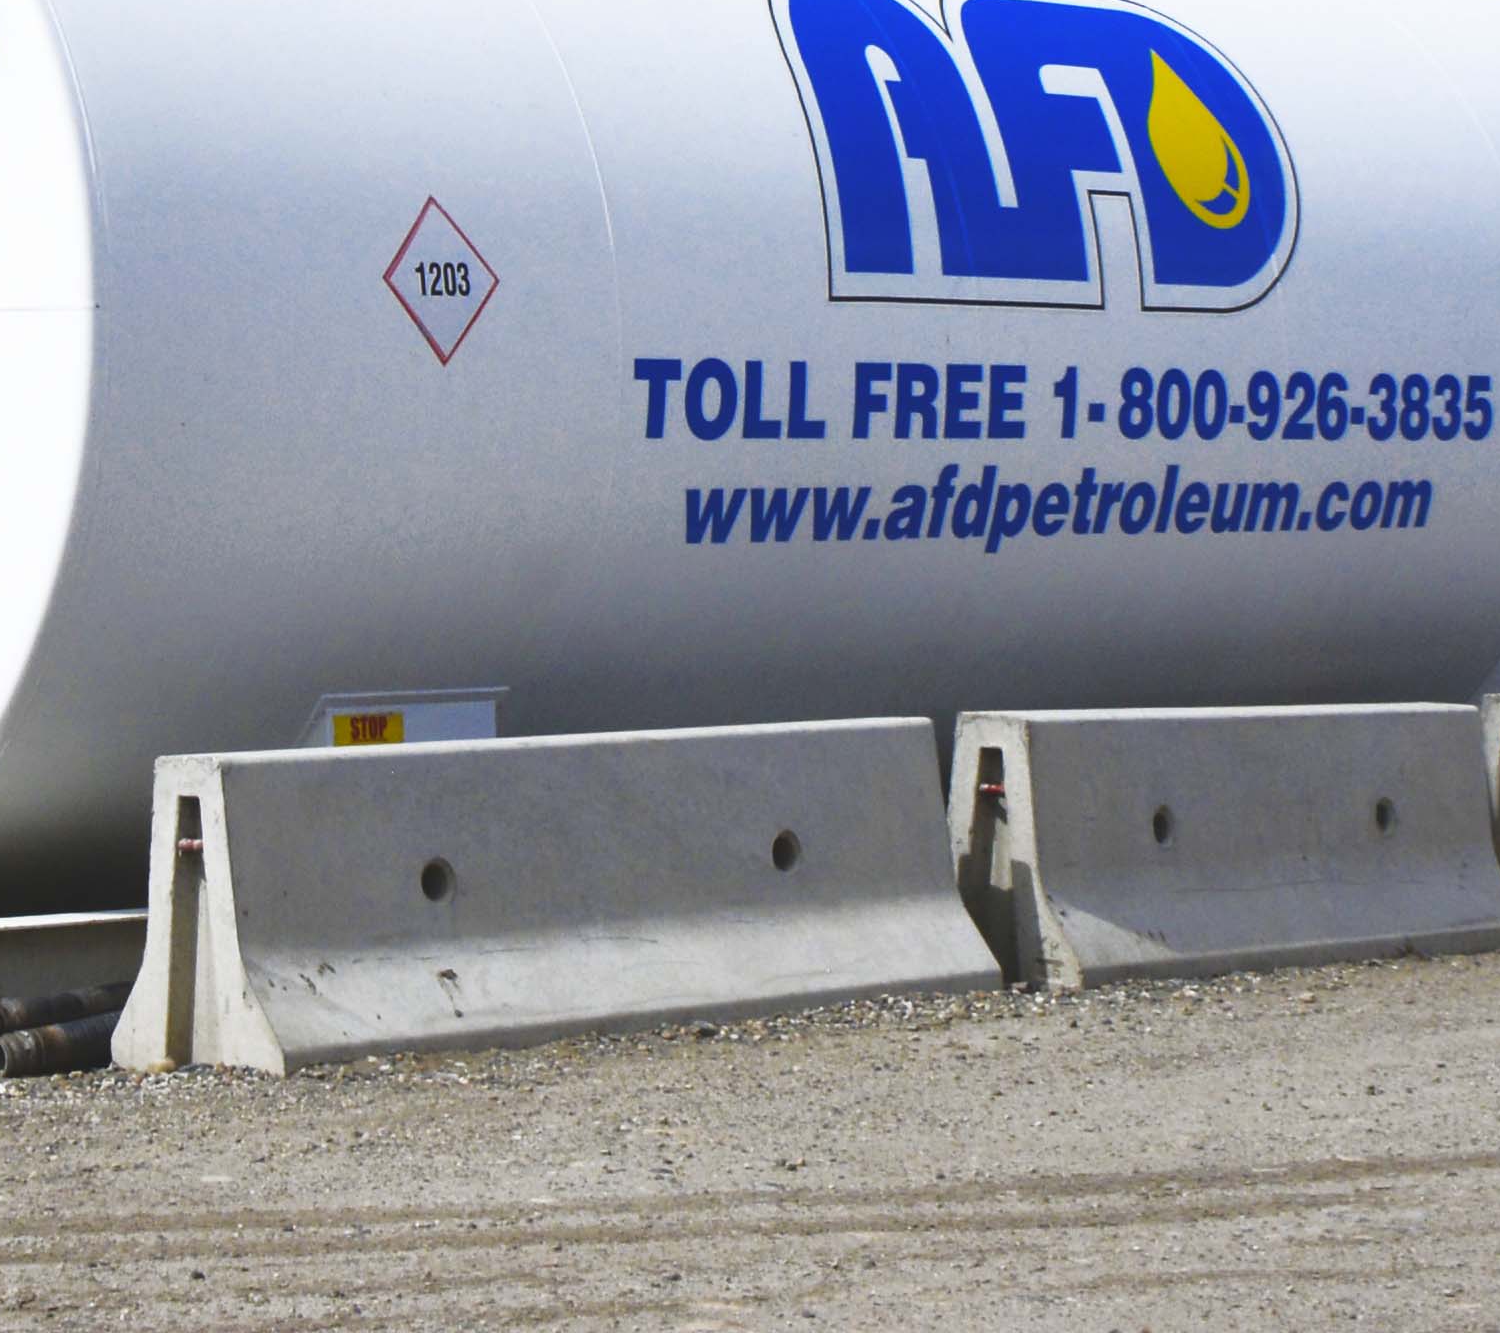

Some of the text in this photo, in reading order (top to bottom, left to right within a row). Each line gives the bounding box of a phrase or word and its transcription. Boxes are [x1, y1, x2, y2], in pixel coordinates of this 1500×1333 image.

[414, 261, 471, 296] 1203
[634, 357, 827, 441] TOLL
[852, 362, 1027, 440] FREE
[685, 463, 1433, 554] www.afdpetroleum.com
[350, 715, 388, 741] STOP
